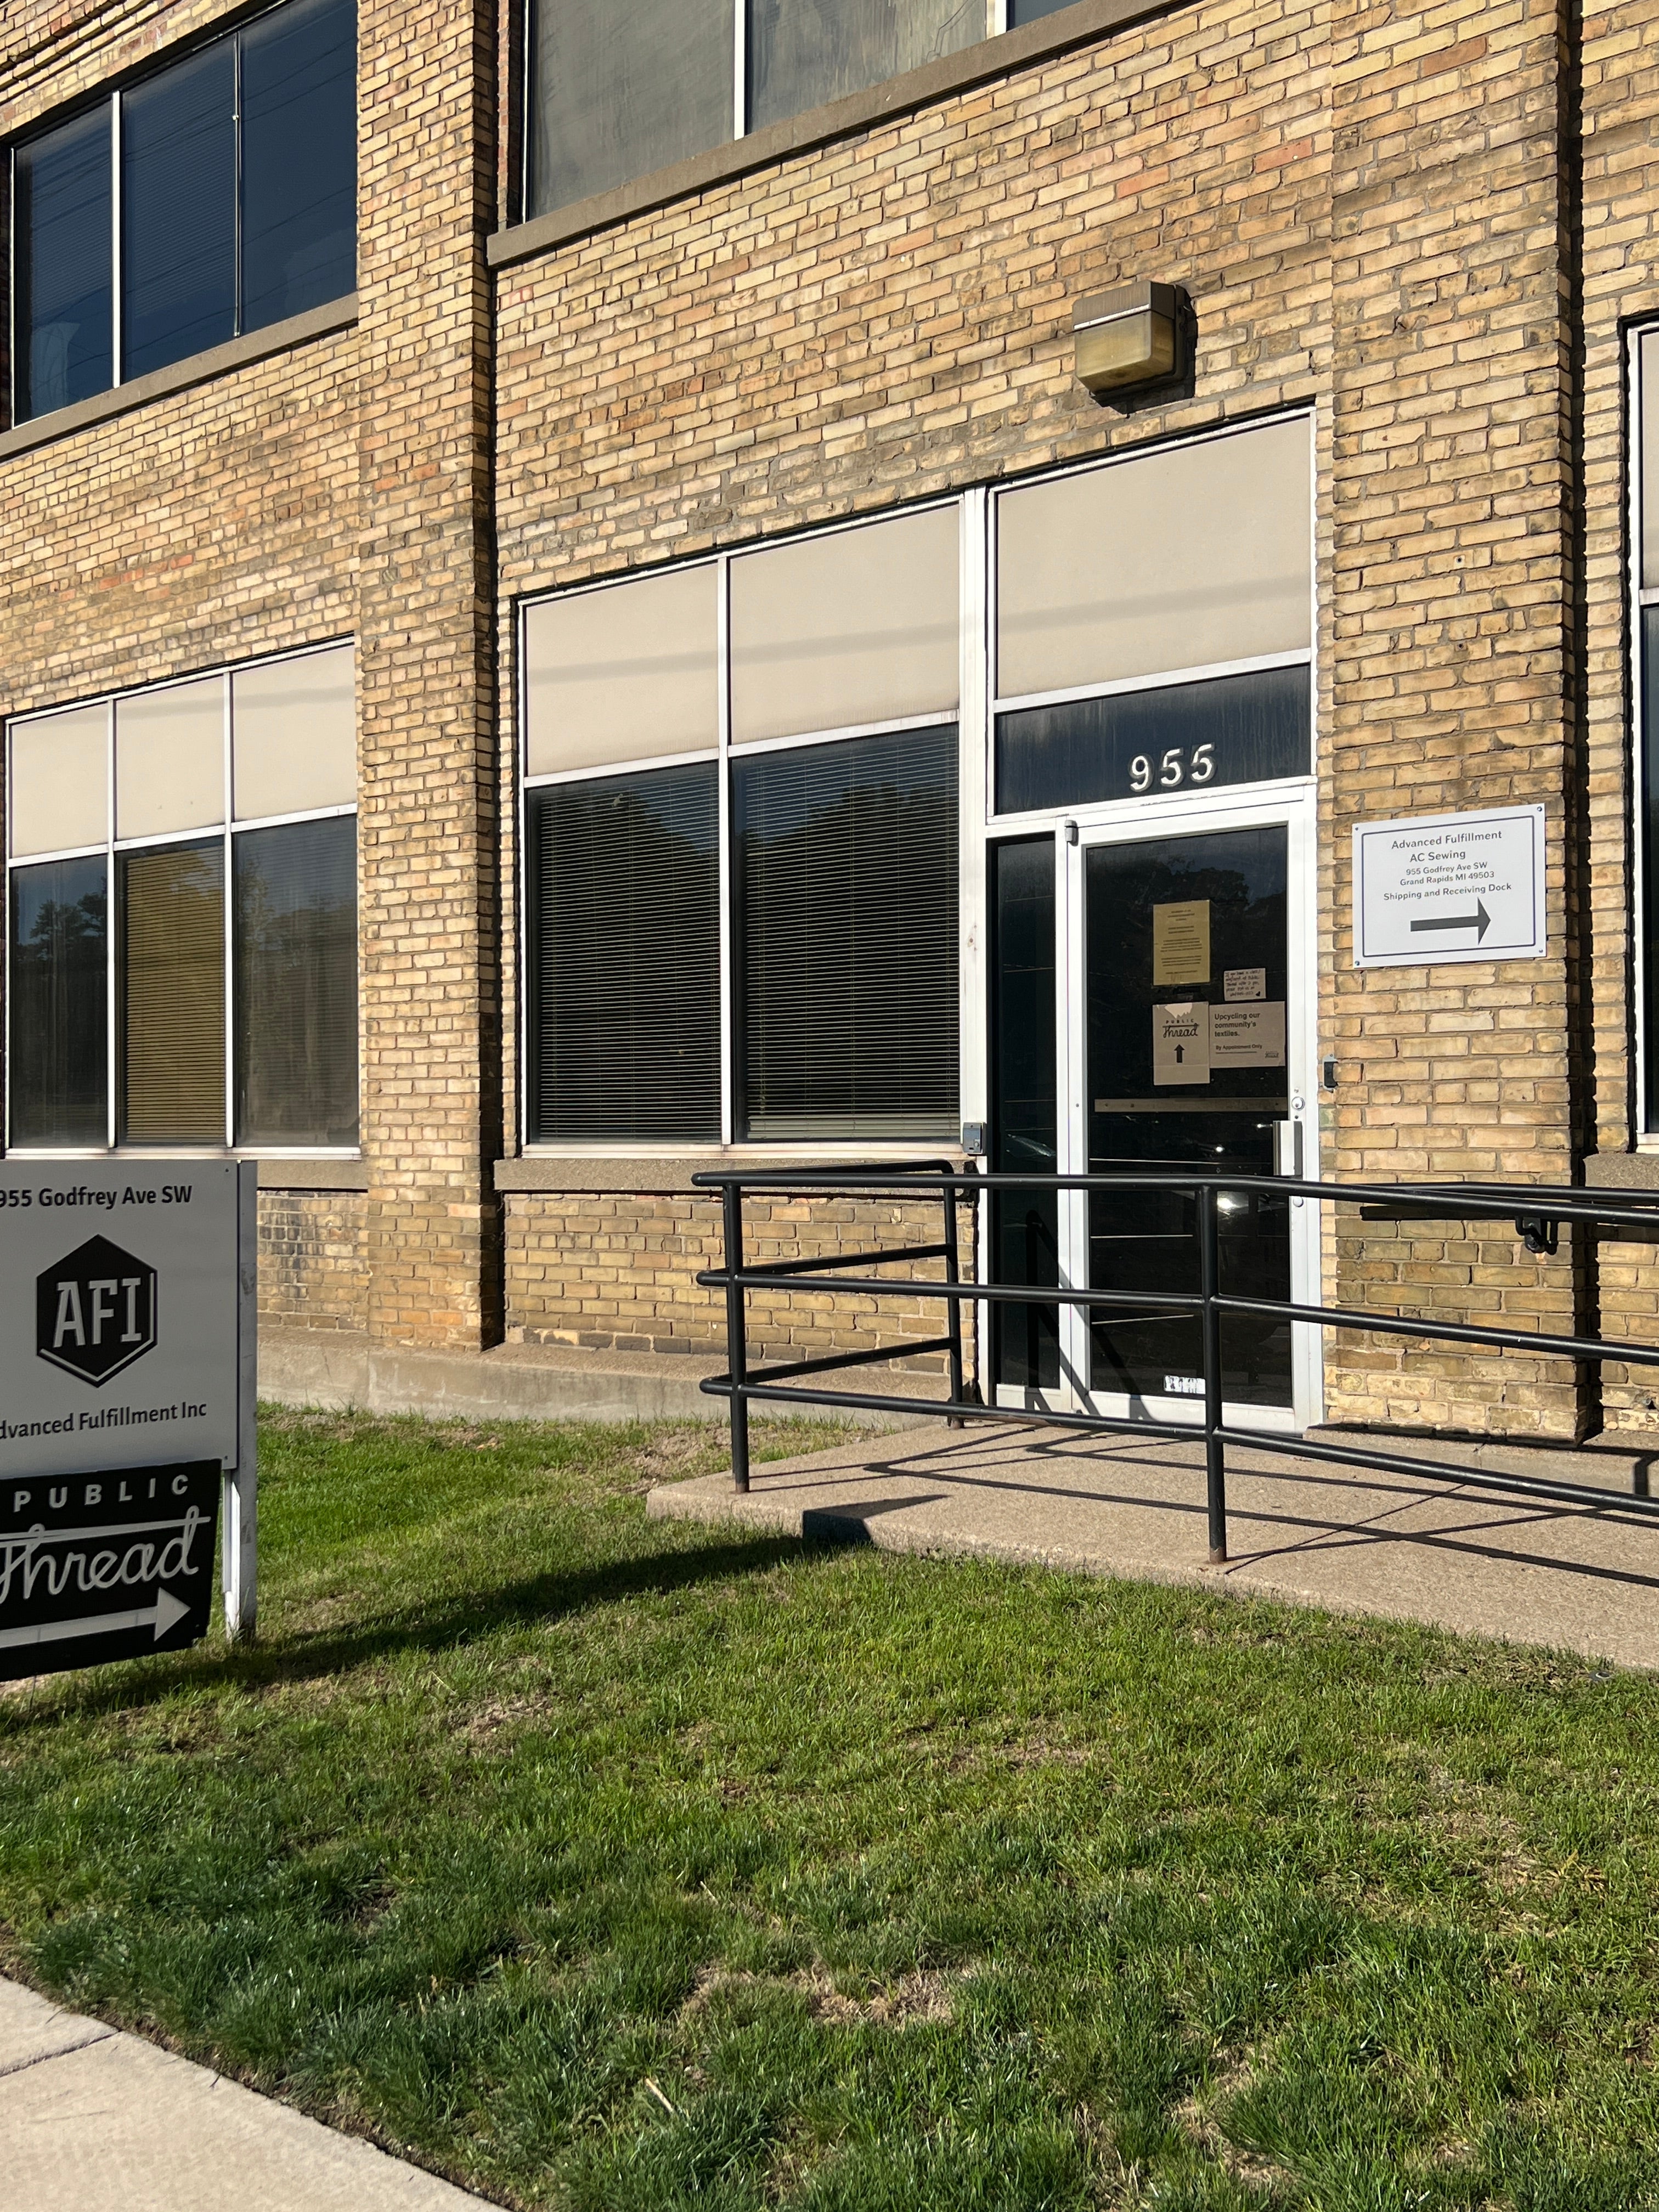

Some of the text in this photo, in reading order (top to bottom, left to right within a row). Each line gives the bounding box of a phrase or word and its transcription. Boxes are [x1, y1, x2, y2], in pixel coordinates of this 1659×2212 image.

[1128, 742, 1216, 792] 955
[1391, 831, 1502, 849] Advanced Fulfillment
[1409, 850, 1466, 862] AC Sewing
[1423, 865, 1454, 874] Godfrey
[1426, 875, 1453, 884] Rapids
[1468, 871, 1494, 879] 49503
[1384, 883, 1511, 901] Shipping and Receiving Dock
[1163, 1023, 1199, 1038] Thread
[0, 1185, 193, 1210] 955 Godfrey Ave SW
[53, 1277, 142, 1348] AFI
[0, 1402, 207, 1439] dvanced Fulfillment Inc
[14, 1475, 189, 1513] PUBLIC
